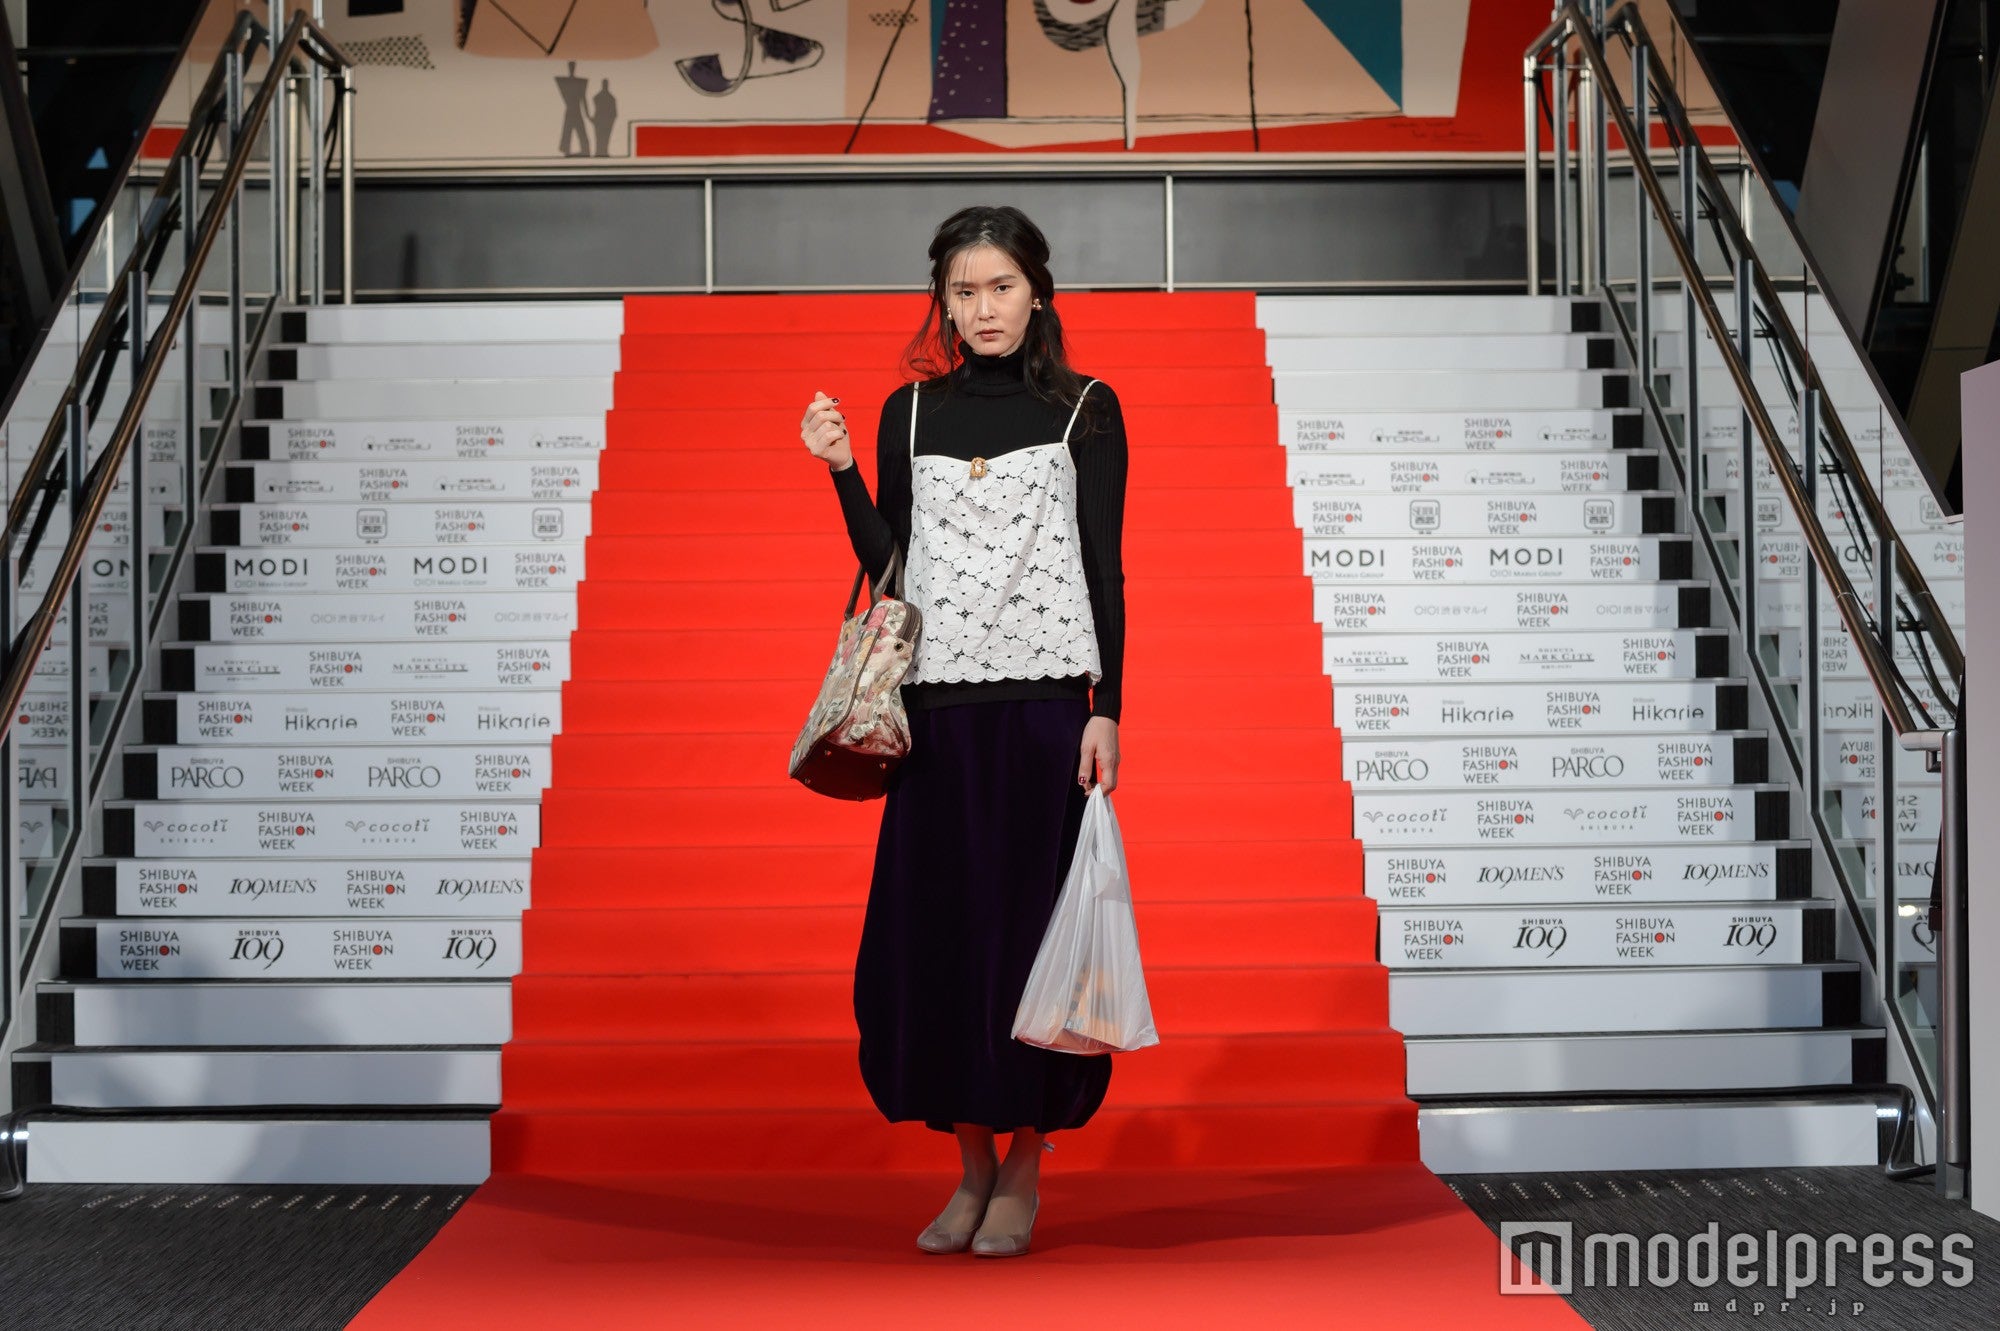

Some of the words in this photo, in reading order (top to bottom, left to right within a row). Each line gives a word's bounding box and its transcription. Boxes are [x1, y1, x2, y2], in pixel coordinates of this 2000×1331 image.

[1464, 418, 1511, 430] SHIBUYA
[288, 428, 335, 440] SHIBUYA
[1465, 429, 1512, 439] FASHION
[288, 440, 336, 449] FASHION
[1312, 501, 1362, 512] SHIBUYA
[1487, 500, 1536, 513] SHIBUYA
[259, 510, 309, 521] SHIBUYA
[434, 509, 485, 521] SHIBUYA
[1313, 513, 1362, 523] FASHION
[1488, 512, 1537, 523] FASHION
[259, 522, 309, 532] FASHION
[435, 521, 485, 531] FASHION
[1313, 525, 1345, 536] WEEK
[1488, 524, 1520, 535] WEEK
[259, 534, 292, 545] WEEK
[435, 533, 468, 544] WEEK
[1412, 545, 1462, 556] SHIBUYA
[1490, 547, 1562, 566] MODI
[1590, 544, 1640, 557] SHIBUYA
[335, 554, 386, 565] SHIBUYA
[514, 552, 566, 565] SHIBUYA
[1311, 549, 1384, 567] MODI
[1413, 558, 1462, 568] FASHION
[1590, 556, 1640, 566] FASHION
[234, 558, 307, 576] MODI
[336, 567, 386, 576] FASHION
[414, 556, 487, 575] MODI
[515, 565, 566, 575] FASHION
[1413, 569, 1445, 581] WEEK
[1590, 567, 1623, 579] WEEK
[336, 578, 369, 590] WEEK
[515, 577, 548, 588] WEEK
[1334, 592, 1385, 604] SHIBUYA
[1517, 592, 1568, 605] SHIBUYA
[230, 601, 282, 612] SHIBUYA
[414, 600, 466, 613] SHIBUYA
[1334, 605, 1386, 616] FASHION
[1517, 605, 1568, 615] FASHION
[231, 614, 282, 624] FASHION
[415, 613, 466, 623] FASHION
[1334, 617, 1368, 628] WEEK
[1517, 618, 1550, 629] WEEK
[231, 626, 264, 637] WEEK
[415, 624, 448, 635] WEEK
[1437, 641, 1489, 653] SHIBUYA
[1623, 637, 1675, 651] SHIBUYA
[309, 650, 362, 662] SHIBUYA
[497, 648, 550, 660] SHIBUYA
[1437, 654, 1490, 665] FASHION
[1623, 650, 1676, 664] FASHION
[310, 664, 362, 674] FASHION
[498, 661, 550, 672] FASHION
[1437, 666, 1472, 677] WEEK
[1623, 663, 1658, 674] WEEK
[310, 676, 344, 687] WEEK
[498, 673, 532, 685] WEEK
[1355, 693, 1408, 705] SHIBUYA
[1547, 691, 1600, 703] SHIBUYA
[198, 701, 252, 712] SHIBUYA
[391, 699, 445, 713] SHIBUYA
[1355, 706, 1409, 717] FASHION
[1547, 704, 1600, 715] FASHION
[199, 713, 252, 724] FASHION
[391, 713, 445, 724] FASHION
[1442, 707, 1514, 723] Hikarie
[1633, 705, 1704, 721] Hikarie
[285, 715, 357, 731] Hikarie
[478, 713, 550, 730] Hikarie
[1355, 719, 1390, 730] WEEK
[1547, 717, 1582, 728] WEEK
[199, 726, 234, 737] WEEK
[391, 725, 426, 736] WEEK
[1462, 746, 1517, 758] SHIBUYA
[1658, 743, 1712, 754] SHIBUYA
[278, 755, 334, 766] SHIBUYA
[475, 754, 530, 766] SHIBUYA
[1463, 759, 1518, 771] FASHION
[1658, 756, 1712, 767] FASHION
[1356, 759, 1429, 782] PARCO
[1552, 755, 1624, 778] PARCO
[171, 766, 244, 789] PARCO
[278, 768, 334, 779] FASHION
[368, 766, 441, 789] PARCO
[476, 768, 531, 778] FASHION
[1463, 772, 1499, 784] WEEK
[1658, 768, 1693, 780] WEEK
[278, 781, 315, 792] WEEK
[476, 781, 512, 792] WEEK
[1477, 800, 1533, 812] SHIBUYA
[1677, 797, 1734, 809] SHIBUYA
[258, 811, 315, 823] SHIBUYA
[460, 811, 517, 823] SHIBUYA
[1477, 814, 1534, 825] FASHION
[1678, 811, 1734, 822] FASHION
[259, 825, 315, 836] FASHION
[460, 824, 517, 836] FASHION
[1477, 827, 1514, 839] WEEK
[1678, 824, 1715, 835] WEEK
[259, 838, 296, 850] WEEK
[460, 838, 497, 850] WEEK
[1388, 859, 1445, 870] SHIBUYA
[1594, 856, 1652, 868] SHIBUYA
[139, 868, 197, 881] SHIBUYA
[347, 869, 405, 883] SHIBUYA
[1388, 872, 1446, 884] FASHION
[1595, 870, 1652, 881] FASHION
[140, 883, 197, 894] FASHION
[347, 884, 405, 895] FASHION
[1388, 886, 1426, 898] WEEK
[1595, 884, 1632, 895] WEEK
[140, 896, 177, 908] WEEK
[347, 897, 385, 909] WEEK
[1404, 920, 1463, 932] SHIBUYA
[1522, 918, 1563, 926] SHIBUYA
[1616, 918, 1674, 929] SHIBUYA
[120, 930, 179, 942] SHIBUYA
[333, 930, 392, 942] SHIBUYA
[1404, 934, 1463, 945] FASHION
[1513, 926, 1567, 958] 109
[1616, 932, 1675, 944] FASHION
[1723, 924, 1777, 956] 109
[120, 945, 180, 956] FASHION
[230, 937, 284, 970] 109
[334, 944, 393, 956] FASHION
[442, 937, 497, 969] 109
[1404, 947, 1443, 959] WEEK
[1616, 945, 1655, 957] WEEK
[120, 958, 159, 970] WEEK
[334, 958, 373, 970] WEEK
